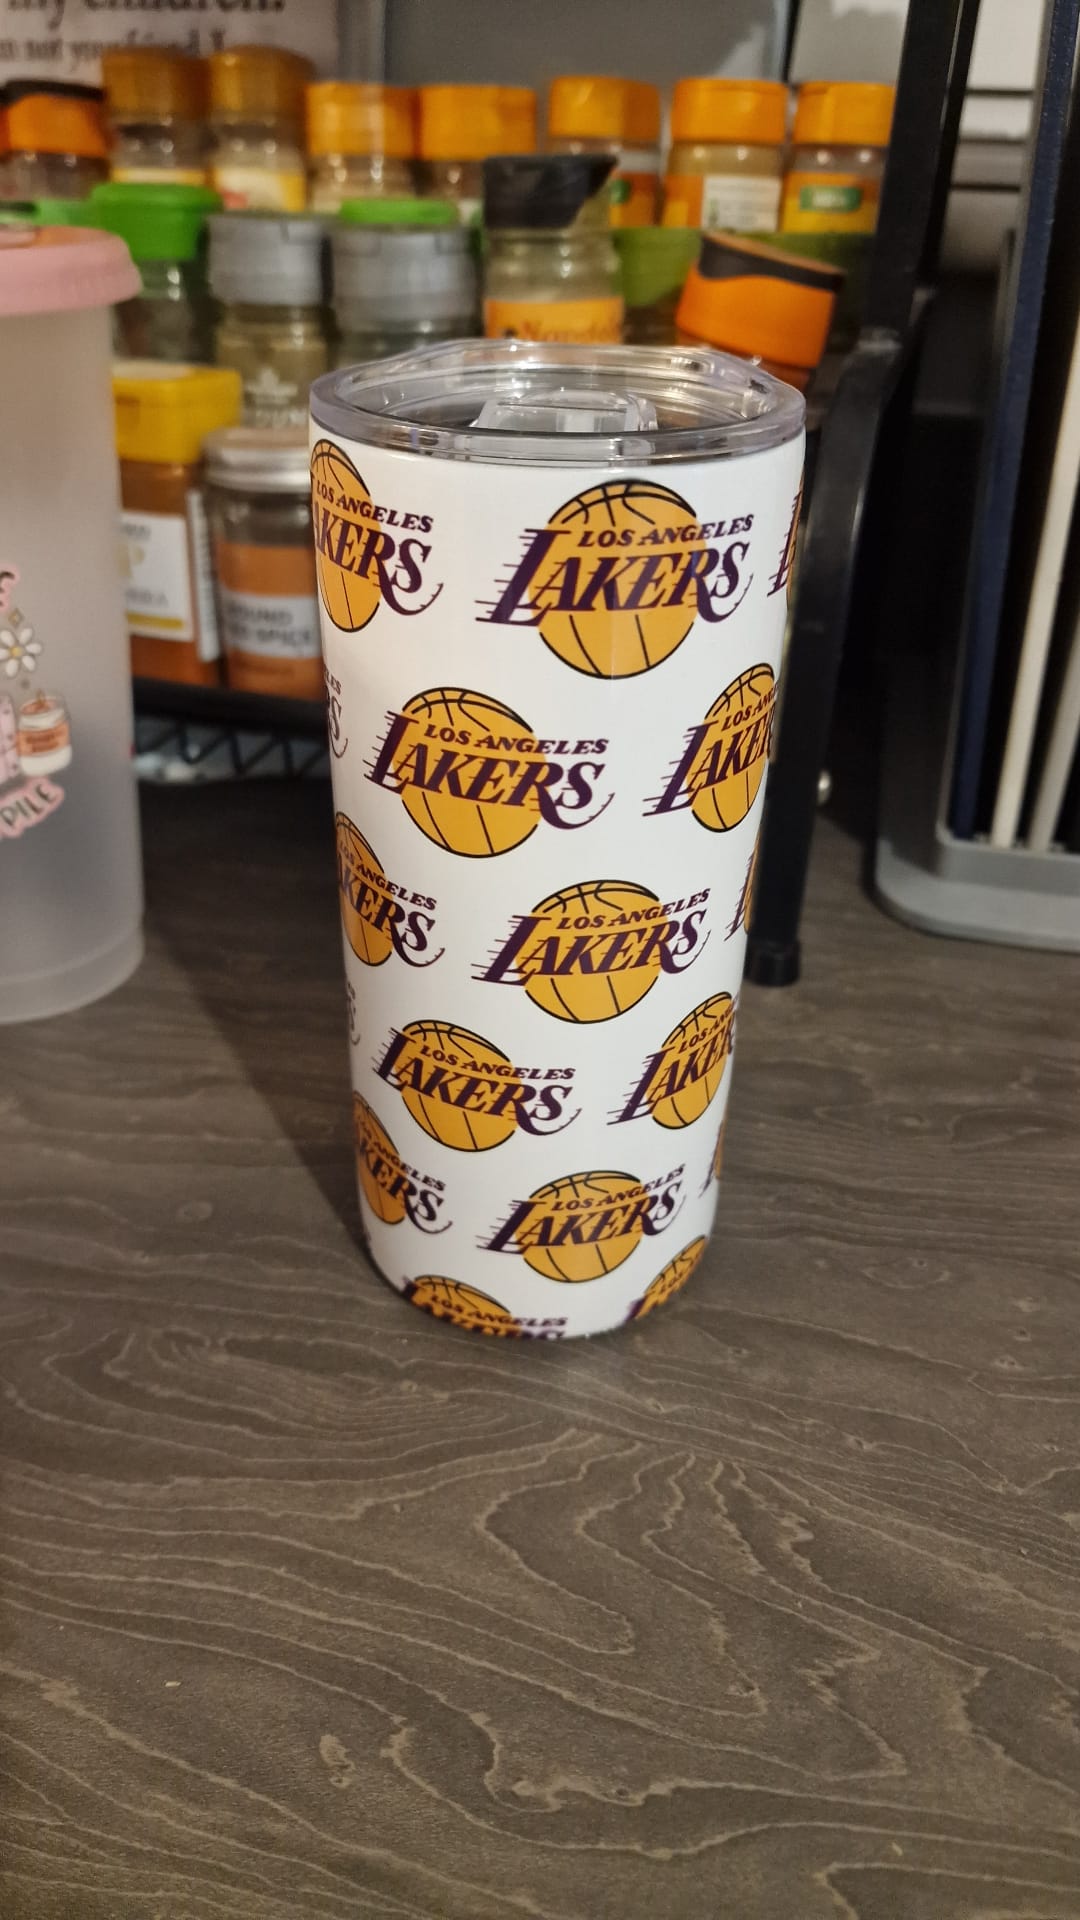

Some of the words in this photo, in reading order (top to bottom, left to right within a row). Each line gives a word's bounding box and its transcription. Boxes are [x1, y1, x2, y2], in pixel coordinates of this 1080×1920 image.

[316, 480, 335, 503] LOS
[336, 493, 434, 533] ANGELES
[577, 529, 633, 547] LOS
[637, 514, 754, 546] ANGELES
[311, 499, 444, 616] AKERS
[474, 527, 754, 627] LAKERS
[424, 724, 471, 745] LOS
[474, 735, 609, 755] ANGELES
[721, 705, 752, 731] LOS
[362, 710, 615, 830] LAKERS
[356, 863, 437, 911] ANGELES
[557, 915, 604, 930] LOS
[608, 888, 711, 927] ANGELES
[471, 909, 712, 987] LAKERS
[420, 1045, 458, 1066] LOS
[461, 1058, 576, 1080] ANGELES
[678, 1028, 709, 1054] LOS
[371, 1027, 582, 1136] LAKERS
[551, 1197, 594, 1211] LOS
[597, 1163, 686, 1206] ANGELES
[475, 1180, 687, 1255] LAKERS
[468, 1311, 568, 1327] ANGELES
